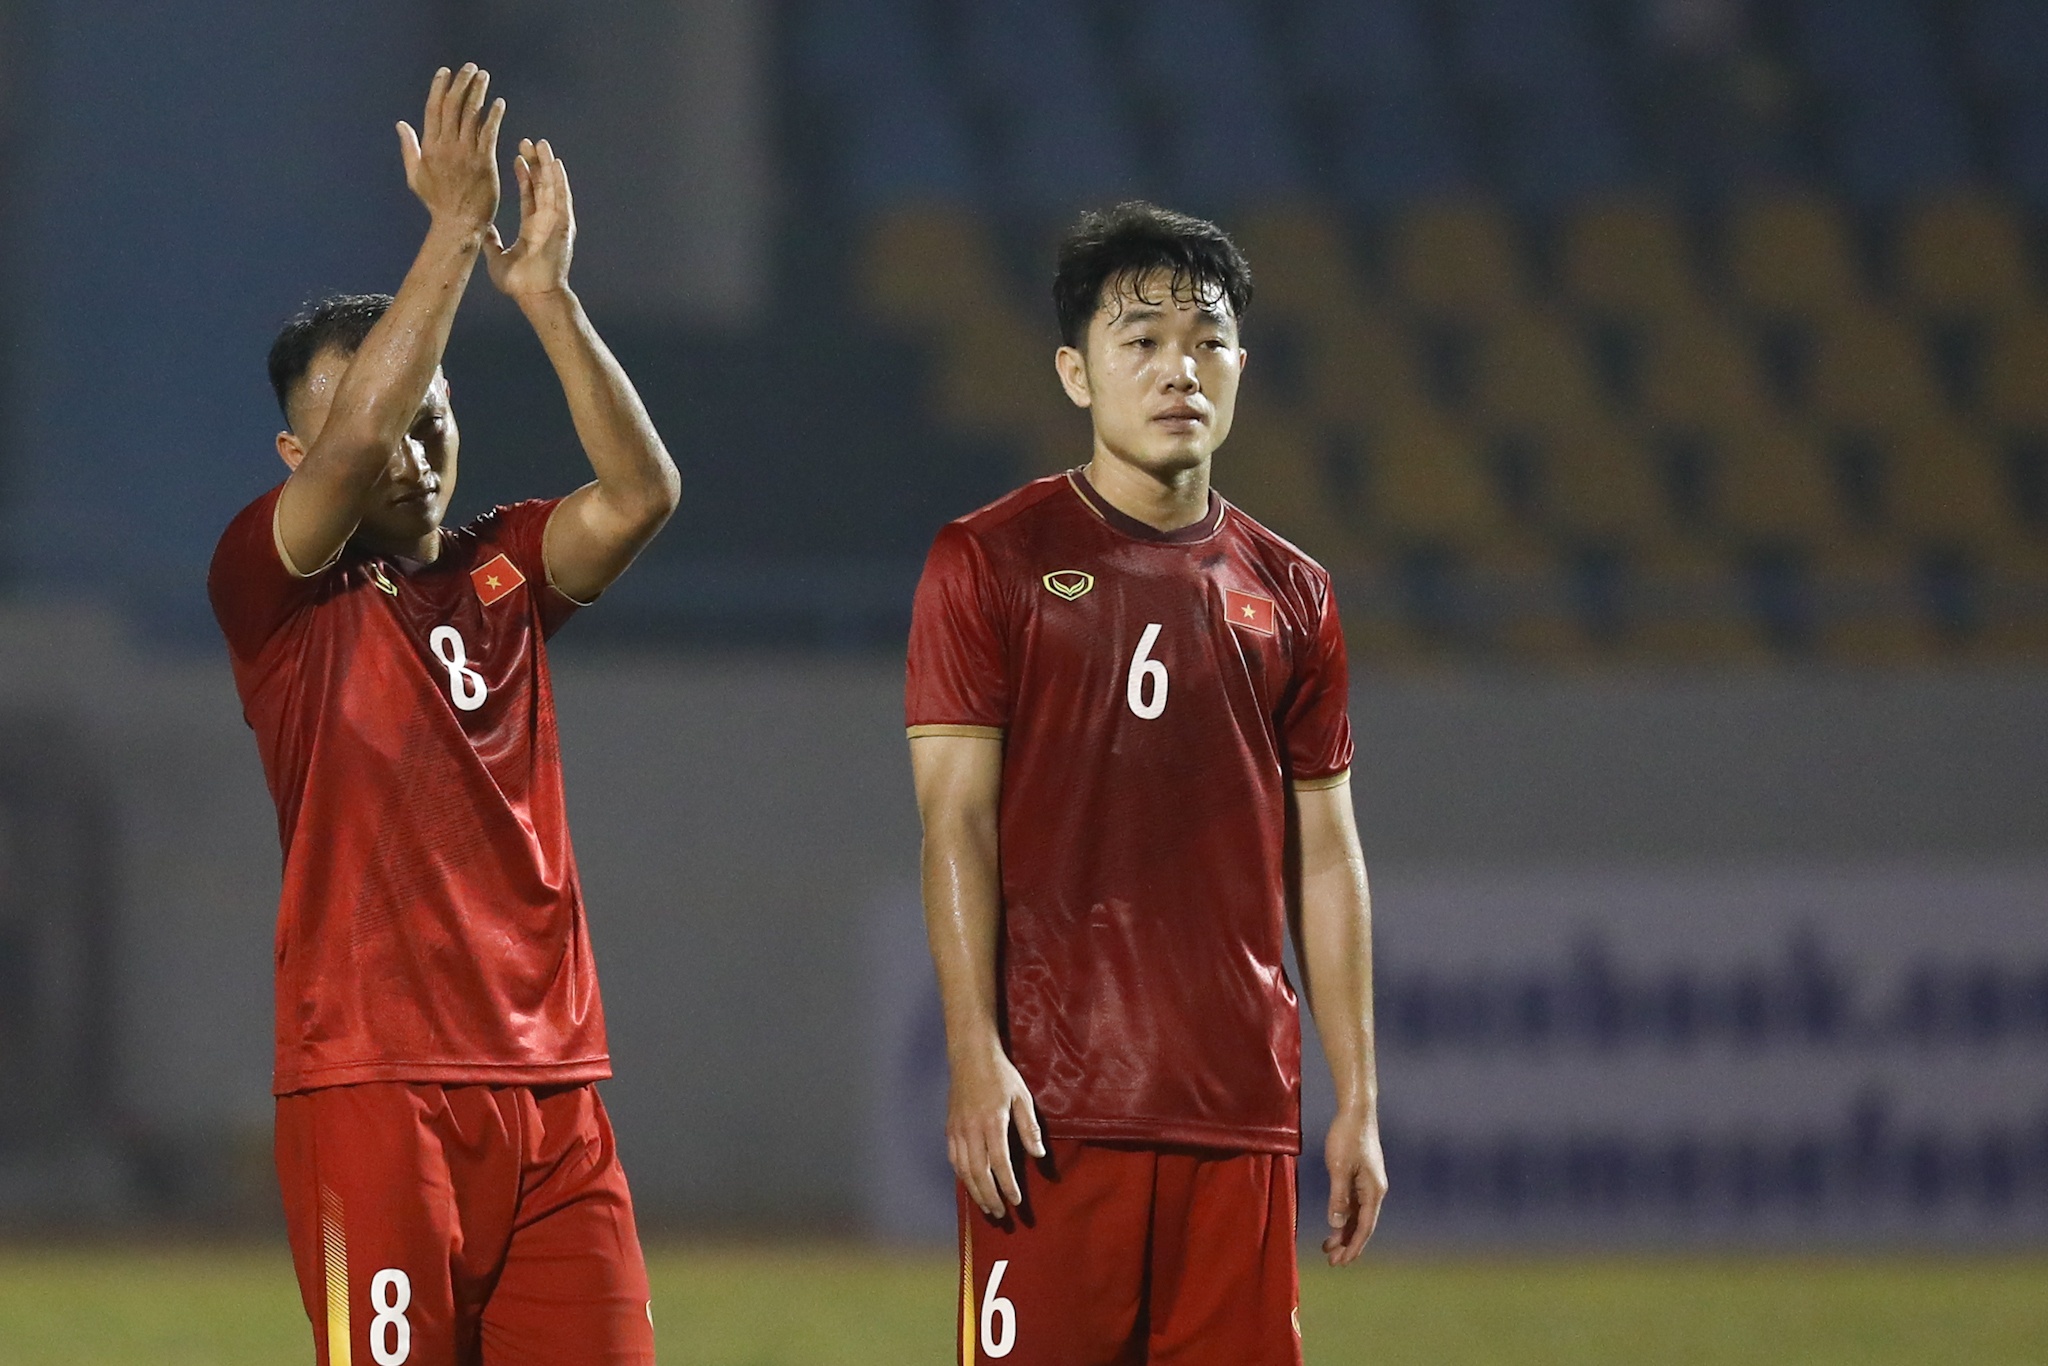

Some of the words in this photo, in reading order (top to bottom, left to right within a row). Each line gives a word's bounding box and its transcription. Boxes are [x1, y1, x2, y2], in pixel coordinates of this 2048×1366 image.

[429, 625, 489, 712] 8
[1126, 623, 1169, 720] 6
[369, 1268, 411, 1366] 8
[980, 1259, 1017, 1359] 6
